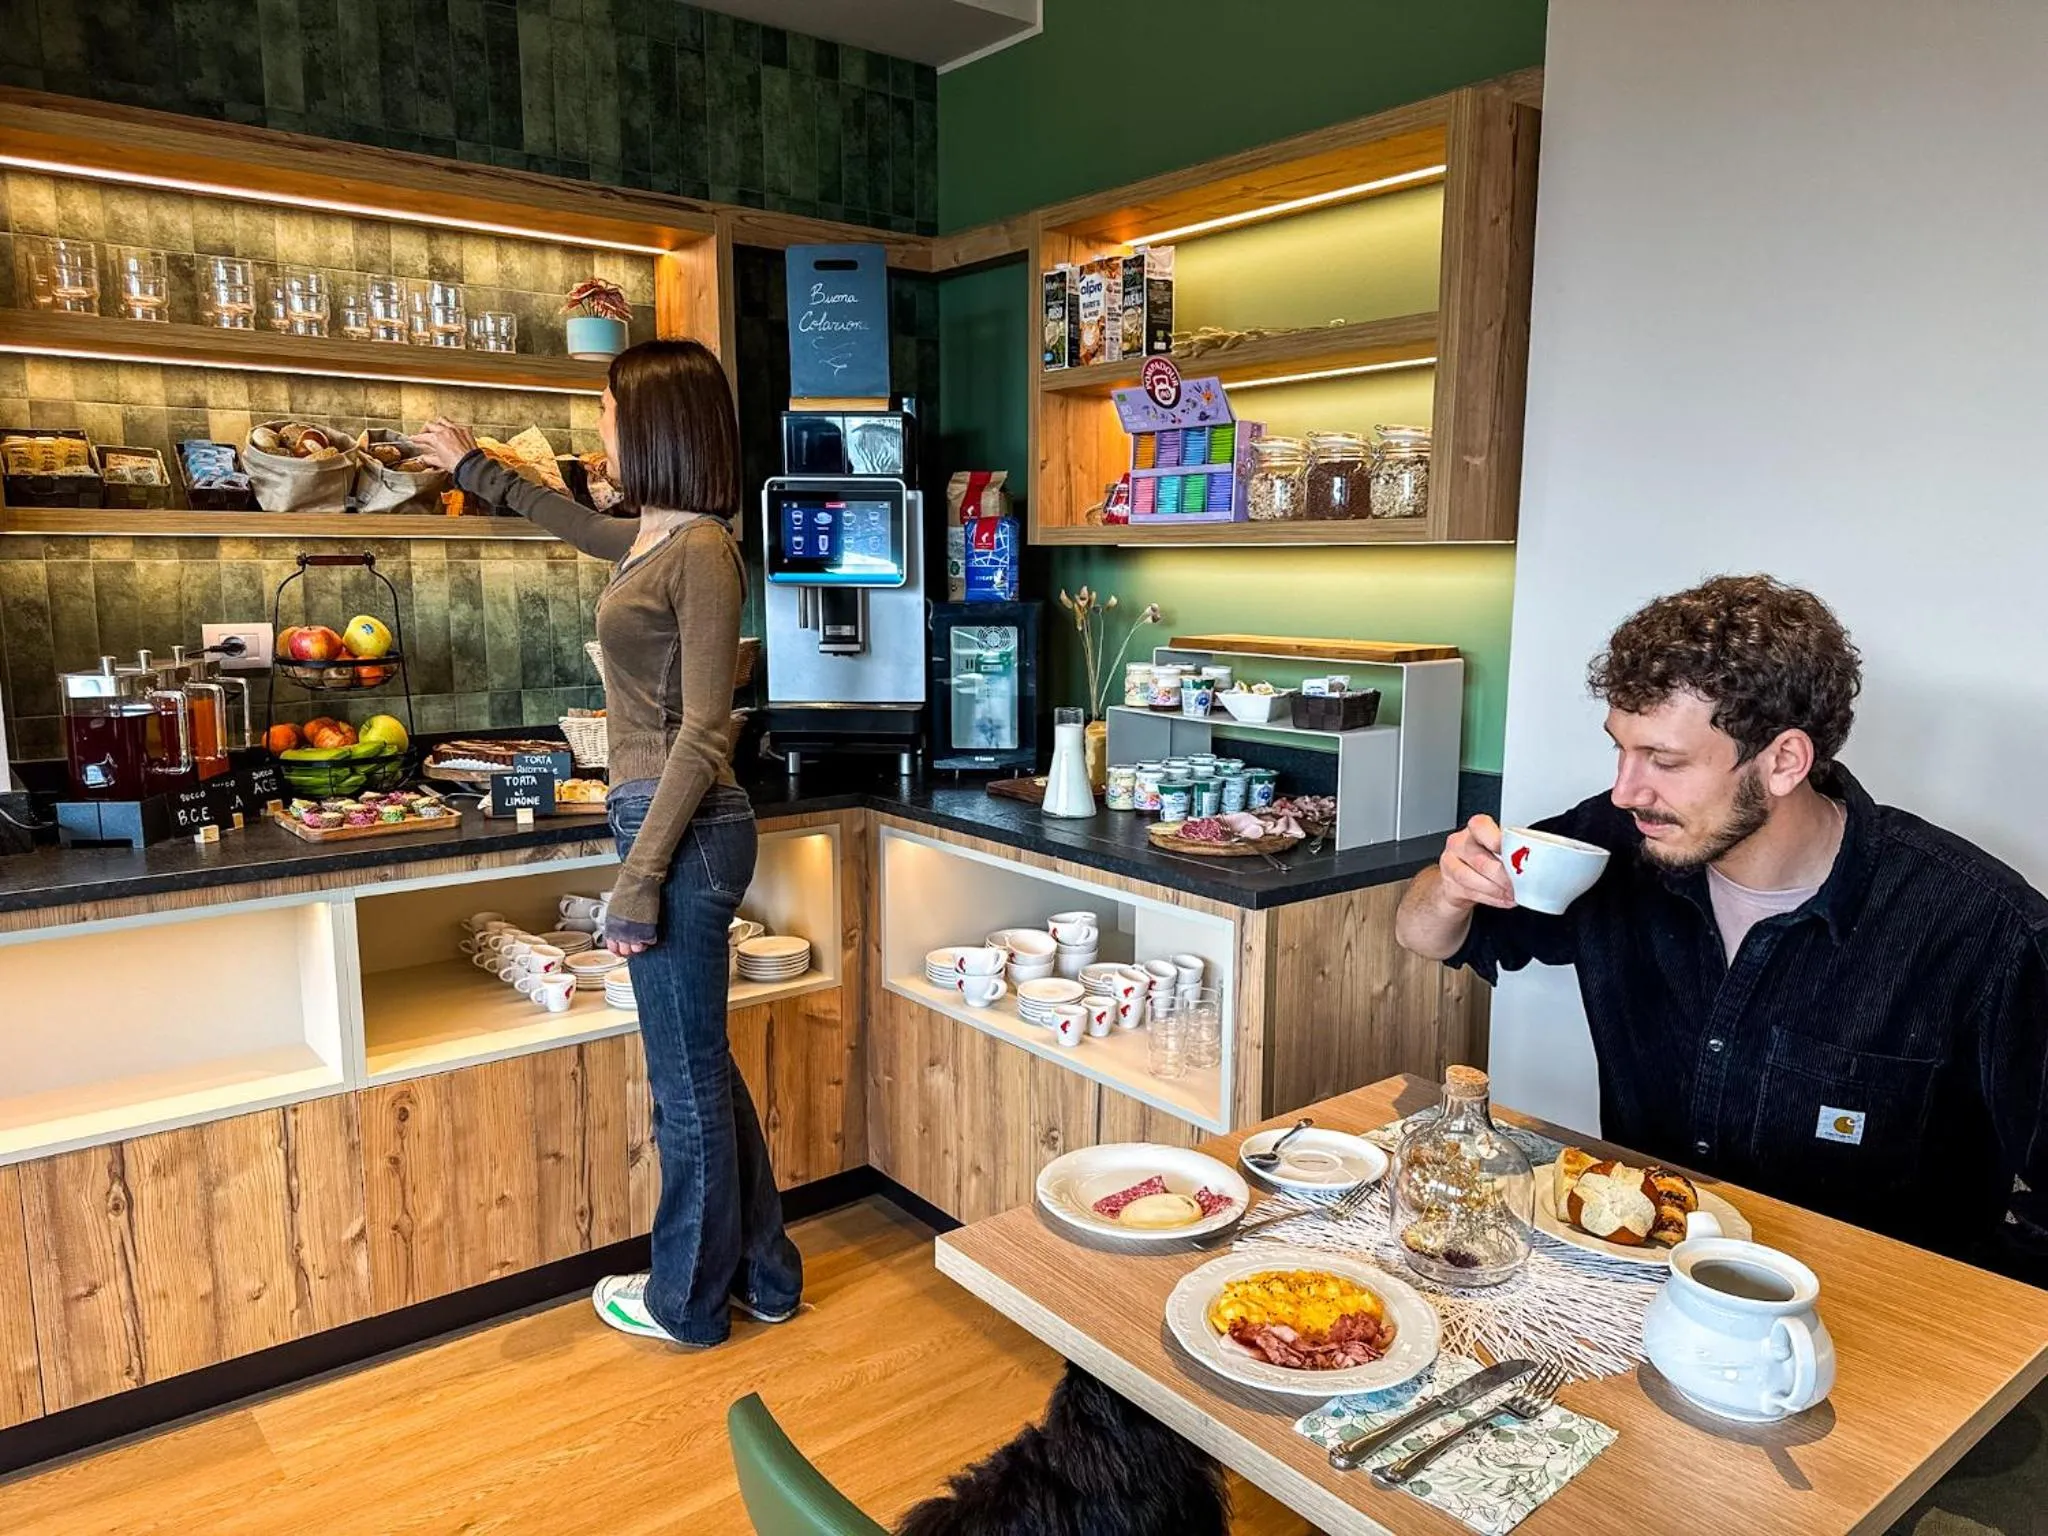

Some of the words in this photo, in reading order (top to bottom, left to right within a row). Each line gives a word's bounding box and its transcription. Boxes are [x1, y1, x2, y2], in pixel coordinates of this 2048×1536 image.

[1080, 281, 1103, 298] alpro
[1145, 361, 1179, 390] POMPADOUR
[524, 755, 552, 764] TORTA
[252, 769, 273, 779] SUCCO
[253, 778, 278, 795] ACE
[503, 775, 538, 787] TORTA
[180, 791, 206, 802] SUCCO
[505, 796, 540, 806] LIMONE
